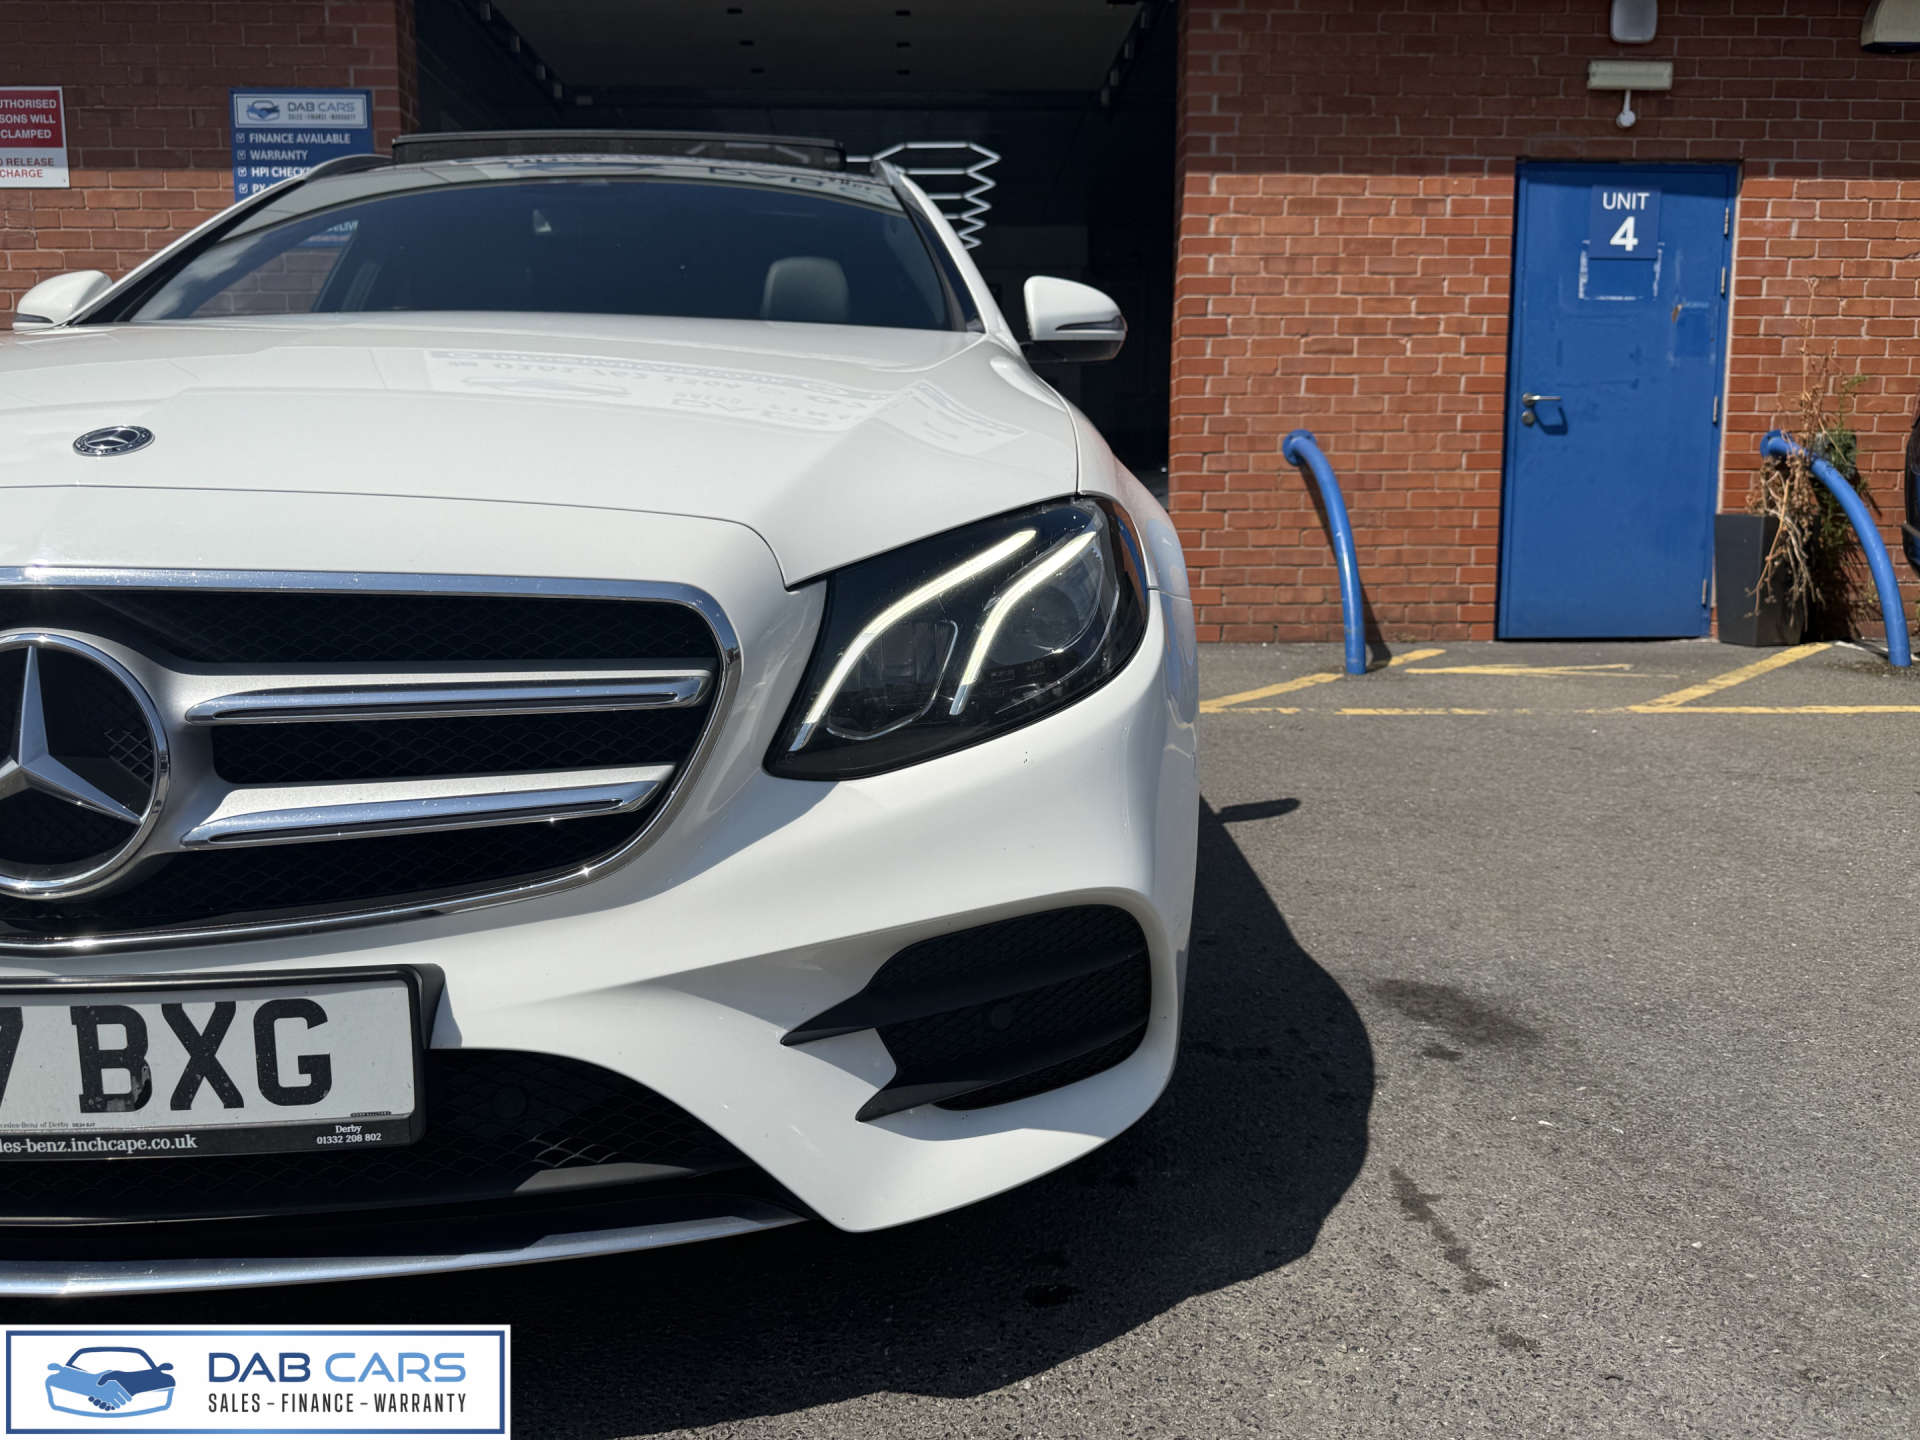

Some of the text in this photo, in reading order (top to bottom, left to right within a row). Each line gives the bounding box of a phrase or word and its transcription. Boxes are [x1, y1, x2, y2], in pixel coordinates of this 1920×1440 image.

[288, 102, 354, 112] DAB CARS
[30, 113, 56, 124] WILL
[0, 128, 52, 139] CLAMPED
[249, 133, 352, 144] FINANCE AVAILABLE
[250, 149, 308, 160] WARRANTY
[6, 157, 55, 167] RELEASE
[0, 168, 43, 178] CHARGE
[251, 166, 269, 177] HPI
[1603, 192, 1650, 210] UNIT
[1610, 216, 1639, 251] 4
[69, 998, 333, 1114] BXG
[335, 1124, 362, 1134] Derby
[316, 1132, 382, 1145] 01332 208 802
